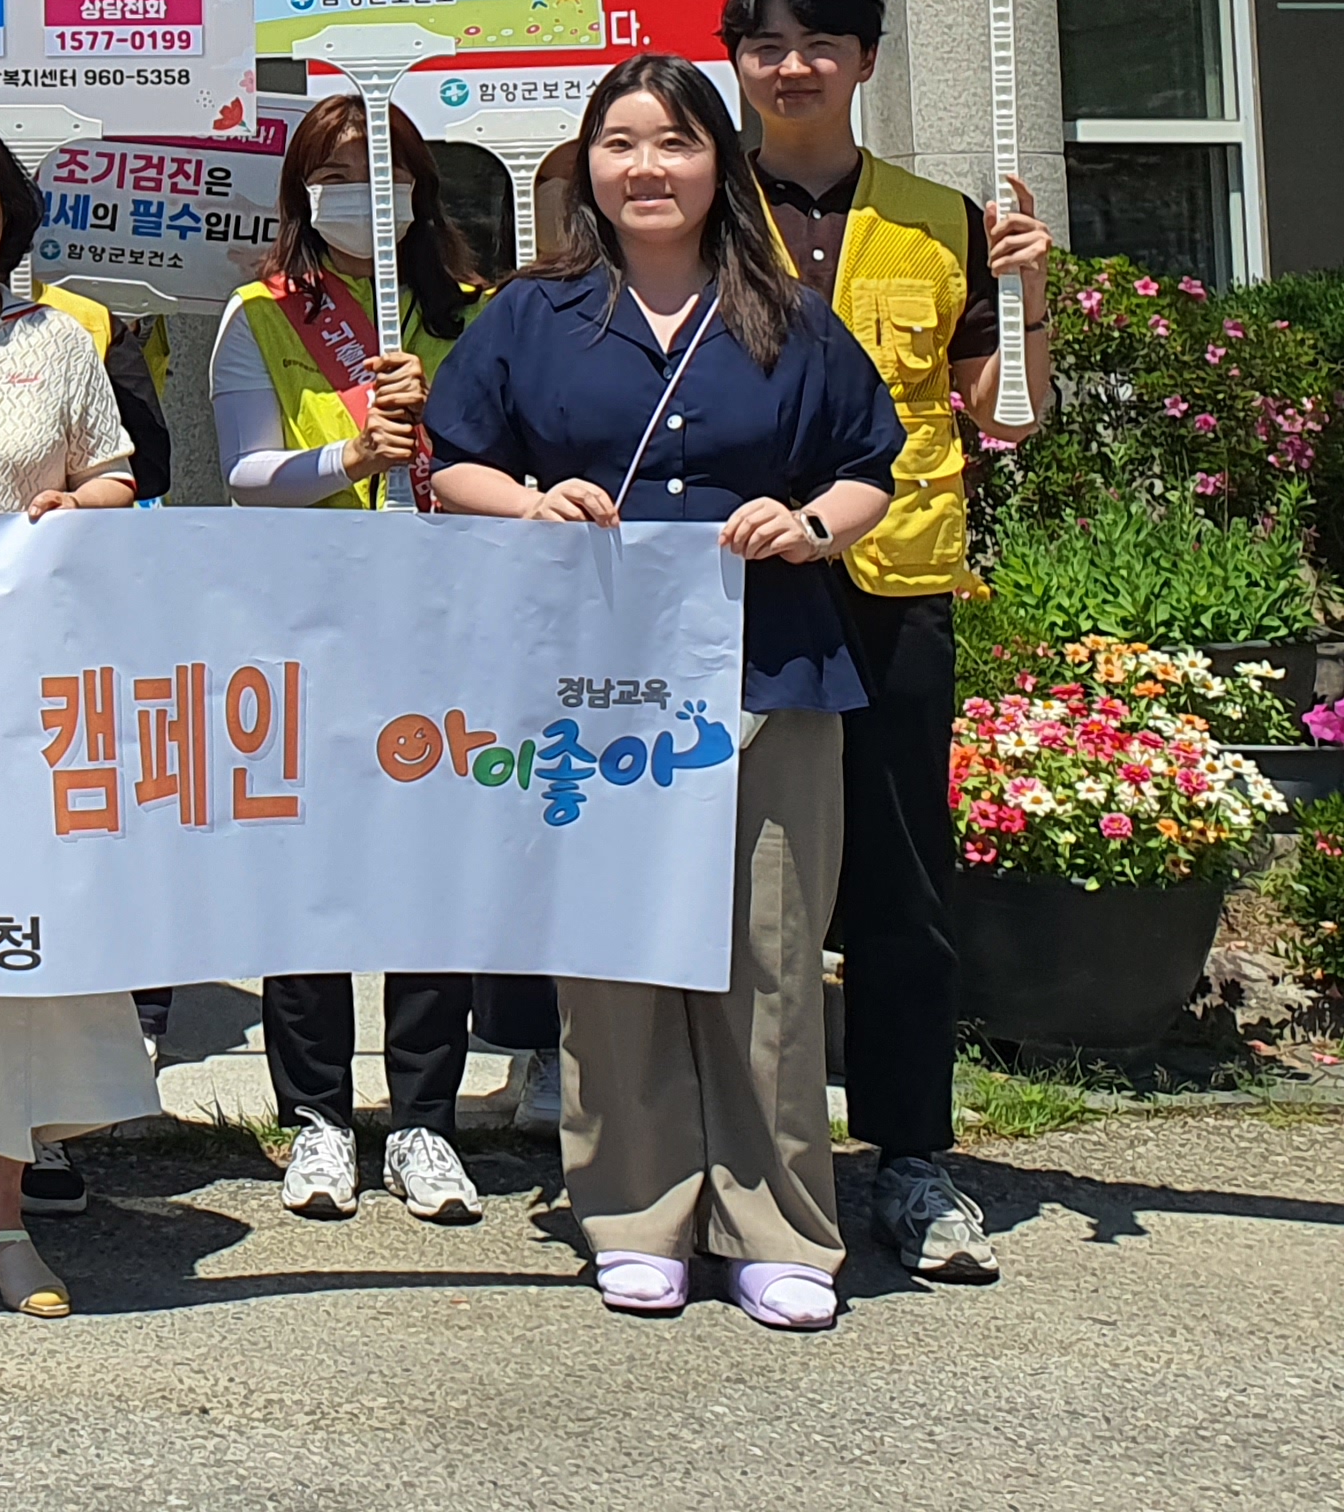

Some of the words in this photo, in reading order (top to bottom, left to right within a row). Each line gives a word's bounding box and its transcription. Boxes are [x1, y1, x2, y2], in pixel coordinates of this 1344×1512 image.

[80, 0, 167, 20] 상담전화
[55, 30, 191, 51] 1577-0199
[84, 68, 190, 87] 960-5358
[53, 148, 233, 197] 조기검진은
[67, 242, 185, 270] 함양군보건소
[557, 677, 672, 710] 경남교육
[39, 660, 301, 836] 캠페인
[376, 708, 733, 827] 아이좋아
